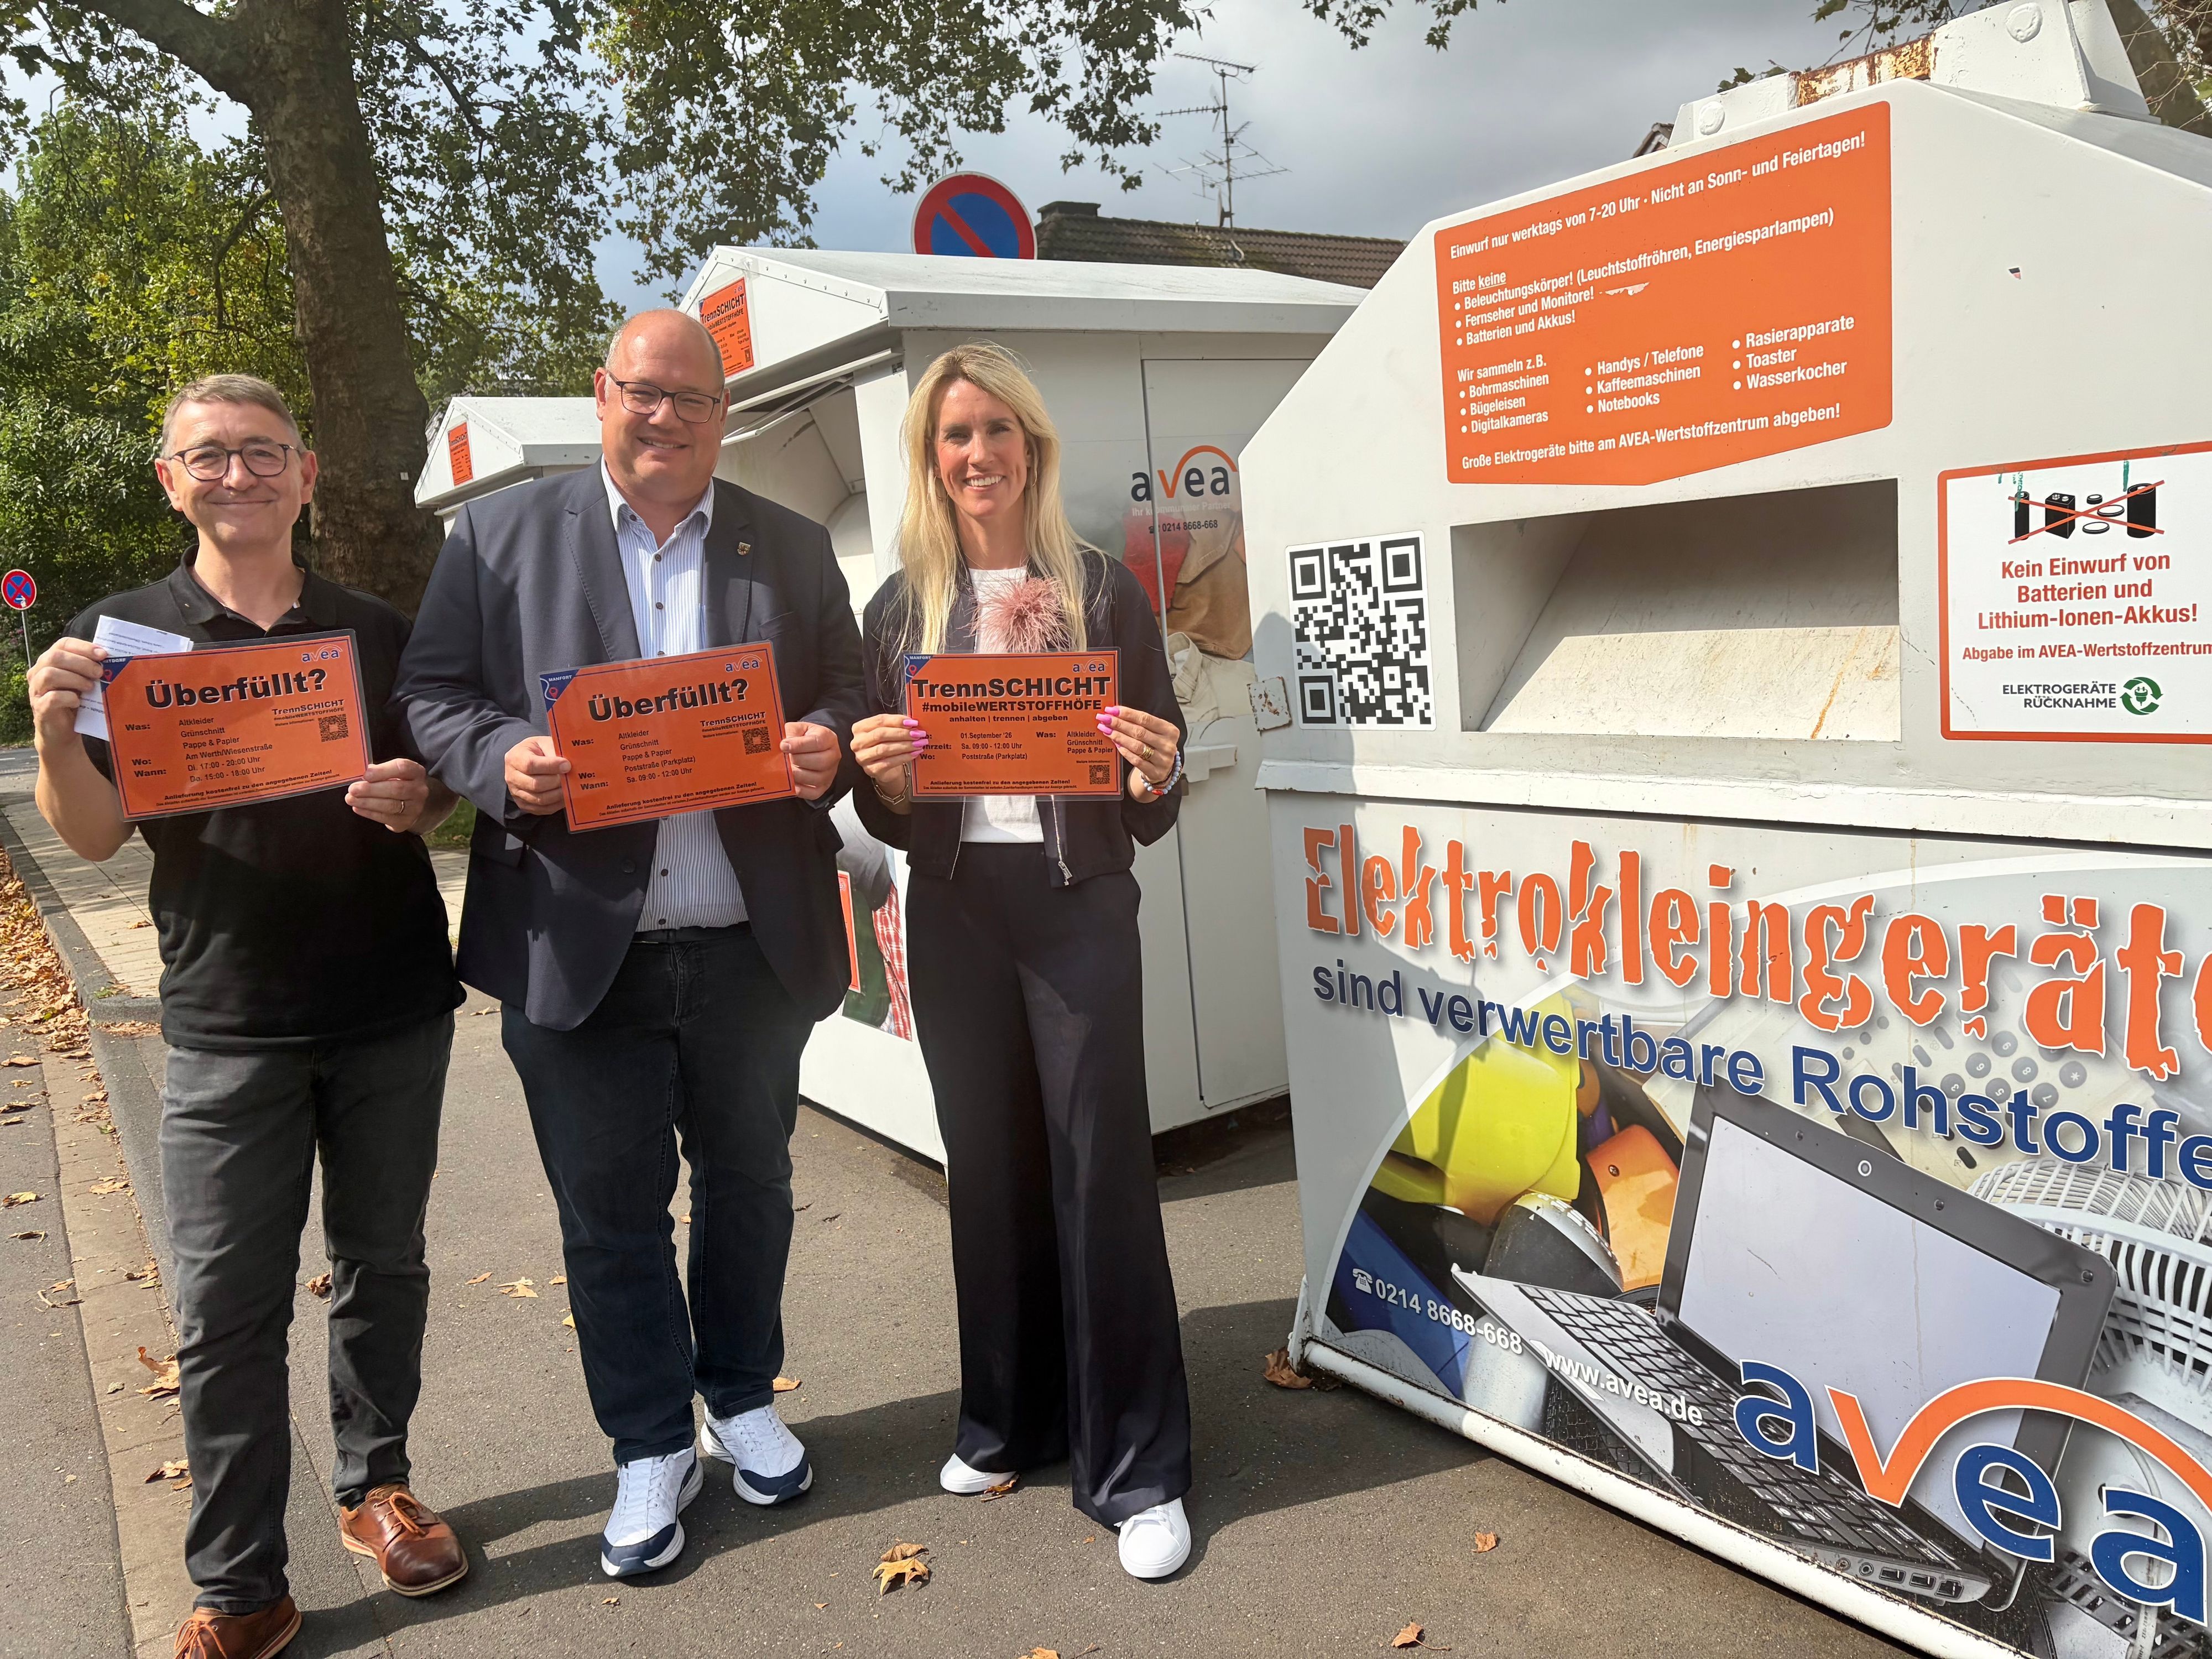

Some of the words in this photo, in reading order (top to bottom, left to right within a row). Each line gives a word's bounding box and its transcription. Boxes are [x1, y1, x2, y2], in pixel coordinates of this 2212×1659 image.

[1451, 236, 1489, 259] Einwurf
[1491, 233, 1509, 248] nur
[1512, 219, 1562, 242] werktags
[1565, 212, 1585, 227] von
[1589, 201, 1616, 221] 7-20
[1619, 197, 1640, 213] Uhr
[1651, 182, 1684, 205] Nicht
[1688, 179, 1704, 194] an
[1708, 169, 1747, 189] Sonn-
[1752, 155, 1778, 176] und
[1783, 131, 1865, 168] Feiertagen!
[1464, 272, 1573, 310] Beleuchtungskörper!
[1577, 247, 1692, 286] (Leuchtstoffröhren,
[1695, 207, 1834, 255] Energiesparlampen)
[1453, 279, 1475, 294] Bitte
[1478, 272, 1506, 290] keine
[1465, 306, 1515, 327] Fernseher
[1518, 299, 1538, 316] und
[1541, 286, 1594, 310] Monitore!
[1467, 326, 1512, 345] Batterien
[1515, 319, 1535, 335] und
[1537, 310, 1575, 330] Akkus!
[1746, 316, 1854, 348] Rasierapparate
[1457, 368, 1474, 382] Wir
[1477, 359, 1523, 379] sammeln
[1526, 354, 1546, 369] z.B.
[1598, 357, 1641, 375] Handys
[1651, 346, 1704, 365] Telefone
[1746, 349, 1797, 368] Toaster
[1469, 374, 1549, 398] Bohrmaschinen
[1597, 366, 1700, 394] Kaffeemaschinen
[1746, 362, 1847, 389] Wasserkocher
[1470, 397, 1525, 416] Bügeleisen
[1598, 392, 1660, 413] Notebooks
[1472, 411, 1548, 434] Digitalkameras
[1462, 454, 1491, 469] Große
[1495, 444, 1566, 465] Elektrogeräte
[1569, 440, 1594, 455] bitte
[1598, 438, 1616, 451] am
[1619, 416, 1768, 448] AVEA-Wertstoffzentrum
[1773, 403, 1839, 427] abgeben!
[1131, 445, 1238, 502] avea
[1162, 523, 1181, 532] 0214
[1183, 520, 1218, 530] 8668-668
[2002, 560, 2042, 578] Kein
[2050, 554, 2126, 576] Einwurf
[2133, 555, 2169, 571] von
[2018, 582, 2106, 603] Batterien
[2115, 579, 2152, 598] und
[1979, 603, 2197, 629] Lithium-Ionen-Akkus!
[301, 644, 343, 662] avea
[725, 654, 762, 672] avea
[1963, 646, 2013, 662] Abgabe
[2018, 646, 2034, 658] im
[1072, 658, 1109, 673] avea
[145, 669, 326, 708] Überfüllt?
[912, 677, 1110, 697] TrennSCHICHT
[2003, 681, 2116, 694] ELEKTROGERÄTE
[272, 699, 344, 715] TrennSCHICHT
[588, 679, 748, 721] Überfüllt?
[922, 698, 1102, 712] #mobileWERTSTOFFHÖFE
[2024, 696, 2116, 708] RÜCKNAHME
[700, 712, 765, 727] TrennSCHICHT
[181, 727, 225, 738] Grünschnitt
[216, 737, 239, 745] Papier
[618, 730, 649, 739] Altkleider
[620, 739, 659, 750] Grünschnitt
[226, 758, 246, 766] 20:00
[624, 761, 659, 772] Poststraße
[661, 756, 696, 768] (Parkplatz)
[134, 769, 166, 778] Wann:
[205, 772, 224, 780] 15:00
[639, 773, 656, 781] 09:00
[581, 782, 608, 790] Wann:
[607, 801, 641, 810] Anlieferung
[643, 795, 672, 804] kostenfrei
[695, 786, 735, 795] angegebenen
[1313, 959, 1404, 1018] sind
[1417, 987, 1765, 1095] verwertbare
[1375, 1279, 1421, 1314] 0214
[1427, 1300, 1522, 1355] 8668-668
[1543, 1351, 1703, 1426] www.avea.de
[1733, 1359, 2212, 1627] avea
